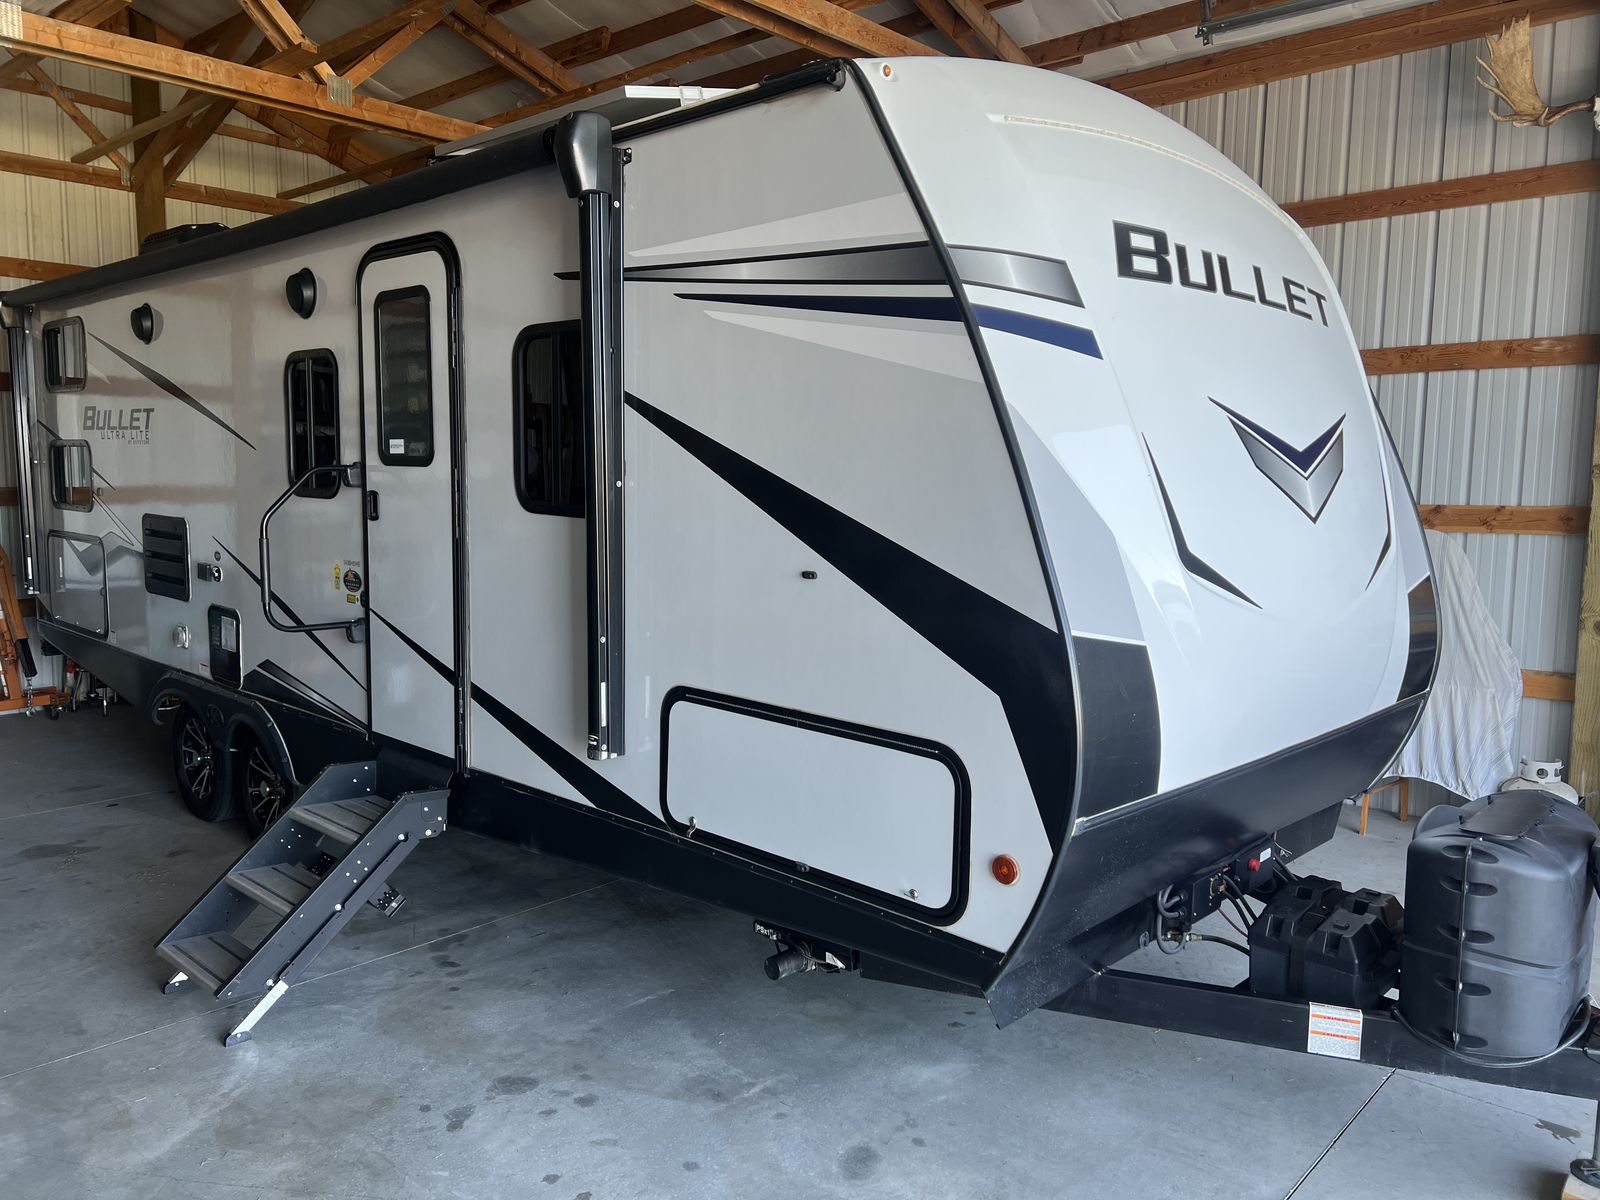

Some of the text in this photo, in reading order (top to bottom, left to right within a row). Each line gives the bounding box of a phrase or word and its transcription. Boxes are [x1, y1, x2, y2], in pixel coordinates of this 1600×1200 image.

[1112, 219, 1329, 328] BULLET
[83, 406, 154, 430] BULLET
[100, 430, 150, 440] ULTRA LITE
